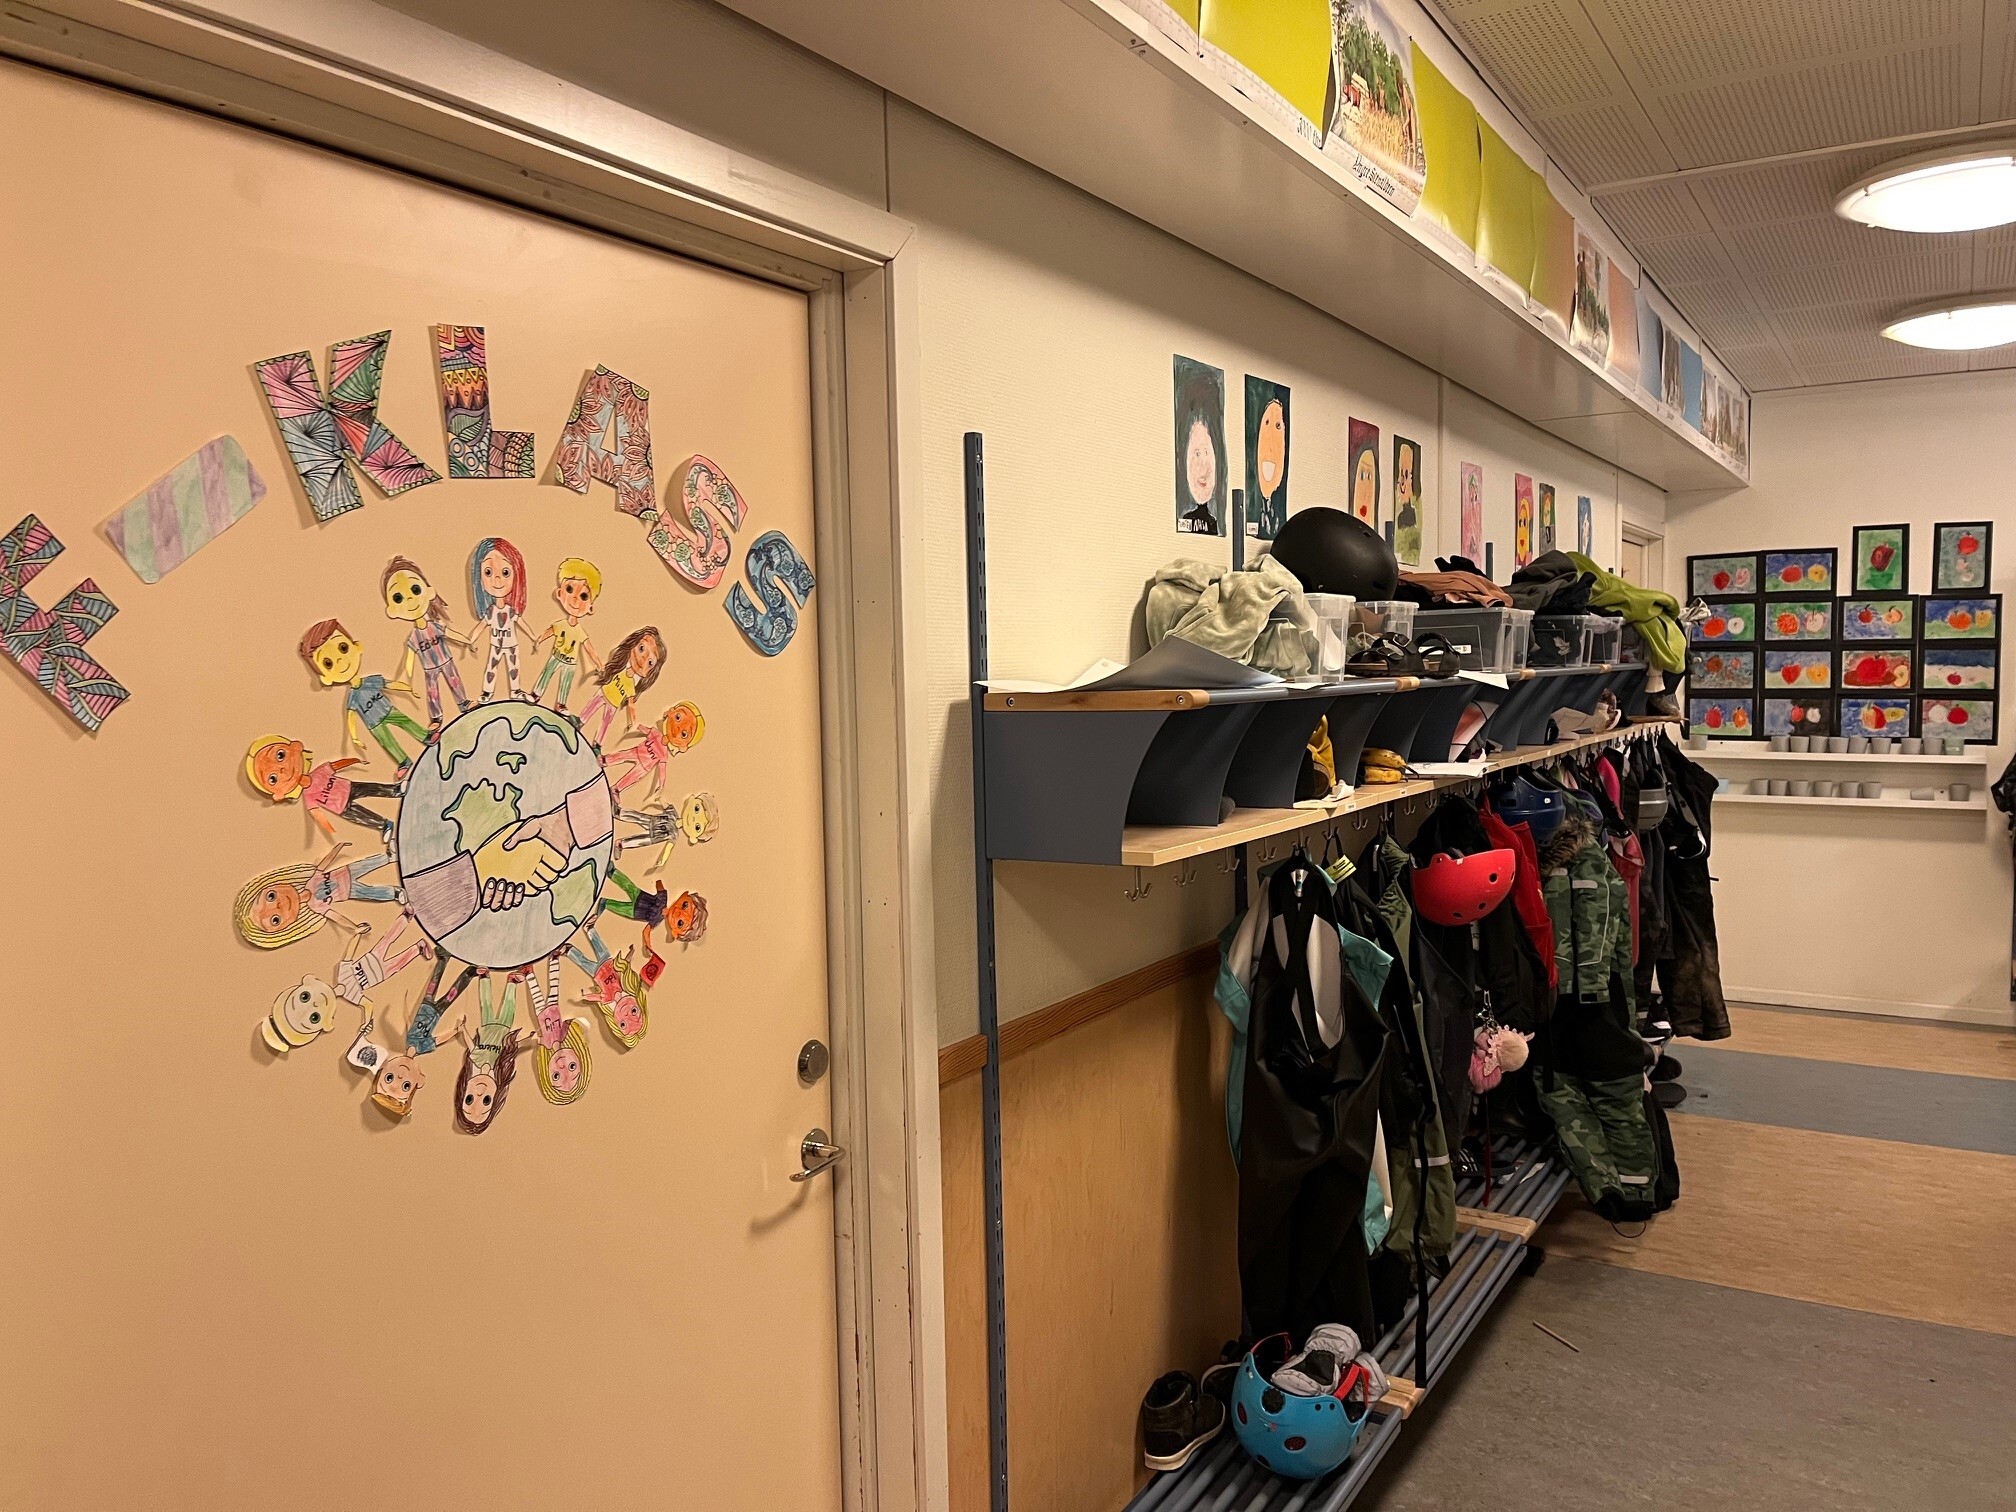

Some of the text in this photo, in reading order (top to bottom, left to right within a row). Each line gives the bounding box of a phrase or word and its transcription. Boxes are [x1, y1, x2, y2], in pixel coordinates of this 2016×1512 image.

[491, 628, 511, 638] Unni
[419, 635, 442, 653] Edith
[361, 692, 384, 715] Loke
[645, 741, 658, 760] Juni
[315, 777, 336, 804] Lilian
[322, 872, 333, 905] Selma
[355, 963, 369, 990] Tilde
[604, 973, 616, 984] Ida
[545, 1018, 561, 1031] Lily
[479, 1044, 501, 1054] Helena
